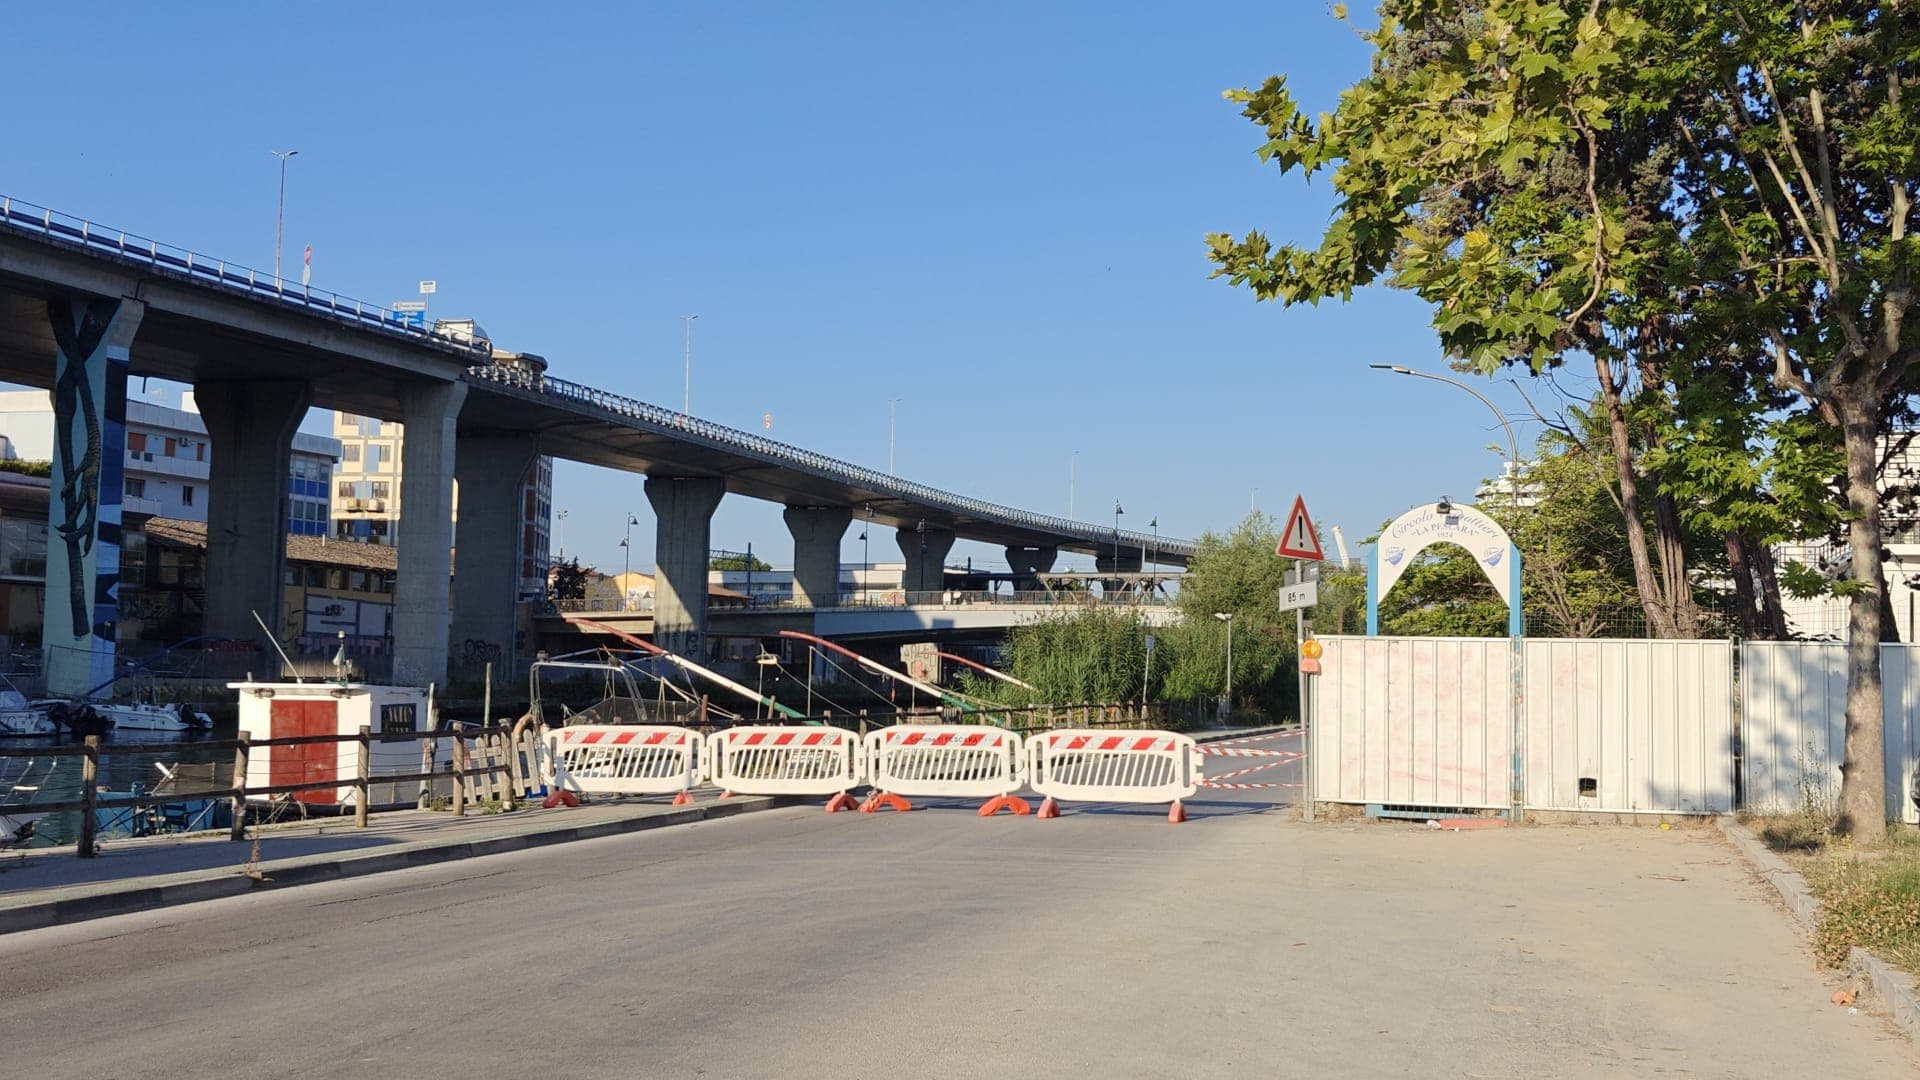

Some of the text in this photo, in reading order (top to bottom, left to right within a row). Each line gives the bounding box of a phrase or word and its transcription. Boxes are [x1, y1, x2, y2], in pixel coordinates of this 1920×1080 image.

[1392, 509, 1433, 539] Circolo
[1287, 592, 1306, 603] 85 m
